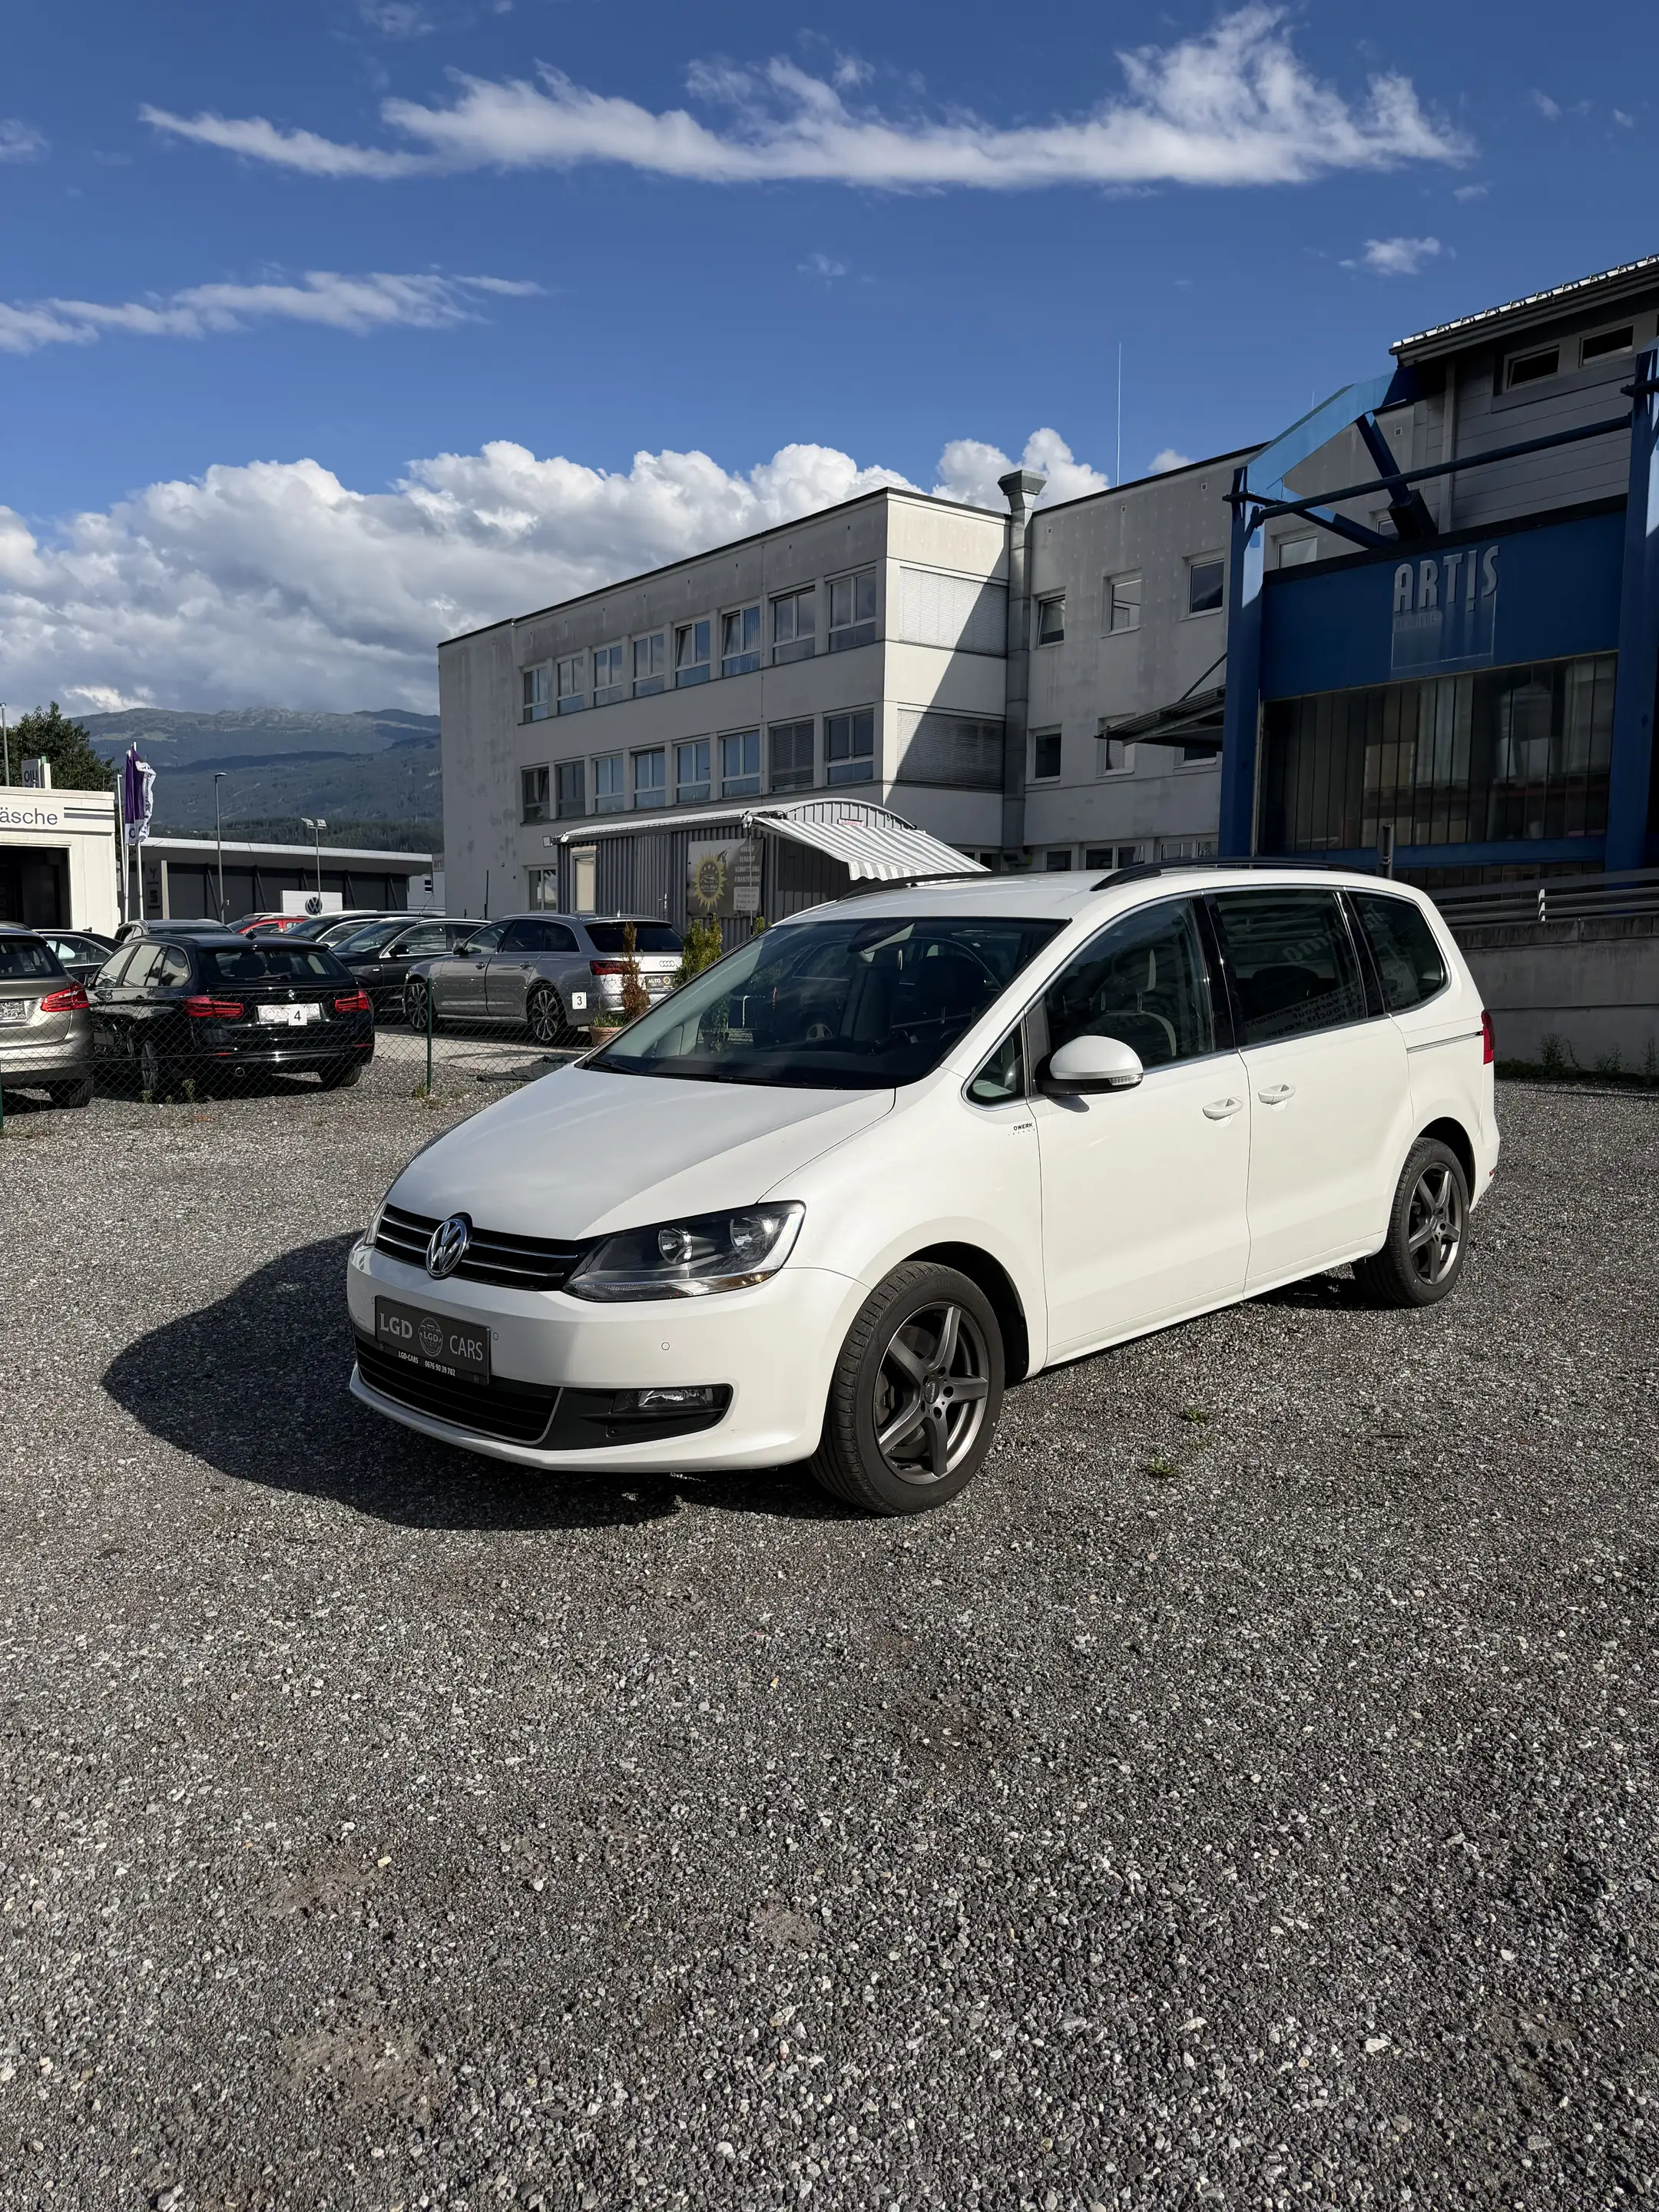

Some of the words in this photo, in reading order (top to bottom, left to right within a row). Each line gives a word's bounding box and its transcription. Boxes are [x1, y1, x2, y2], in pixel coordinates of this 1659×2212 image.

[577, 995, 583, 1005] 3
[293, 1010, 302, 1022] 4
[379, 1313, 413, 1339] LGD
[423, 1331, 439, 1342] LGD
[449, 1335, 483, 1361] CARS
[398, 1351, 419, 1364] LGD-CARS
[425, 1360, 435, 1369] 0676
[435, 1363, 442, 1372] 90
[441, 1365, 447, 1373] 39
[447, 1367, 456, 1376] 782
